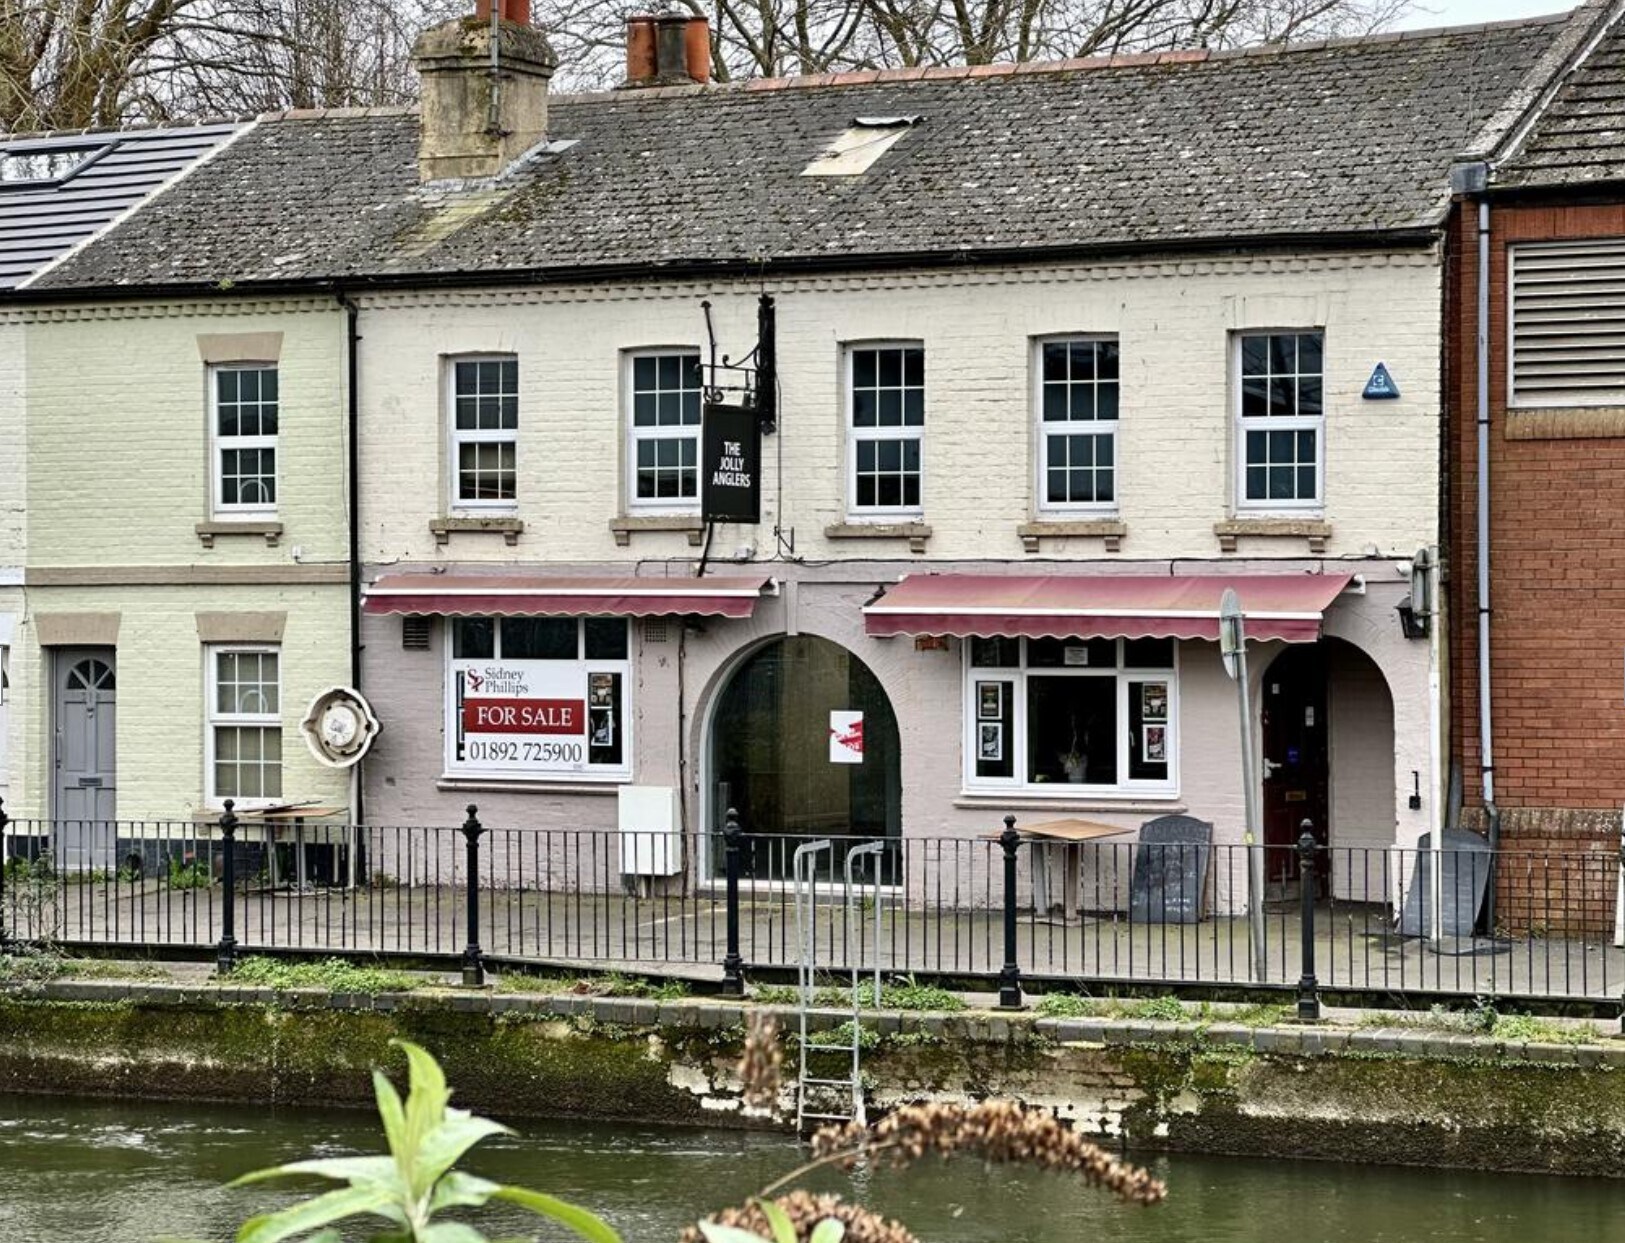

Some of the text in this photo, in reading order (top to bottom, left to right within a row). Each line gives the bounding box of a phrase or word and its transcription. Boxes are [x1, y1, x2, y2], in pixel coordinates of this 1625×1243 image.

[723, 441, 741, 456] THE
[719, 456, 745, 471] JOLLY
[712, 471, 751, 487] ANGLERS
[485, 666, 524, 680] Sidney
[485, 680, 529, 697] Phillips
[477, 706, 573, 727] FOR SALE
[470, 741, 582, 762] 01892 725900
